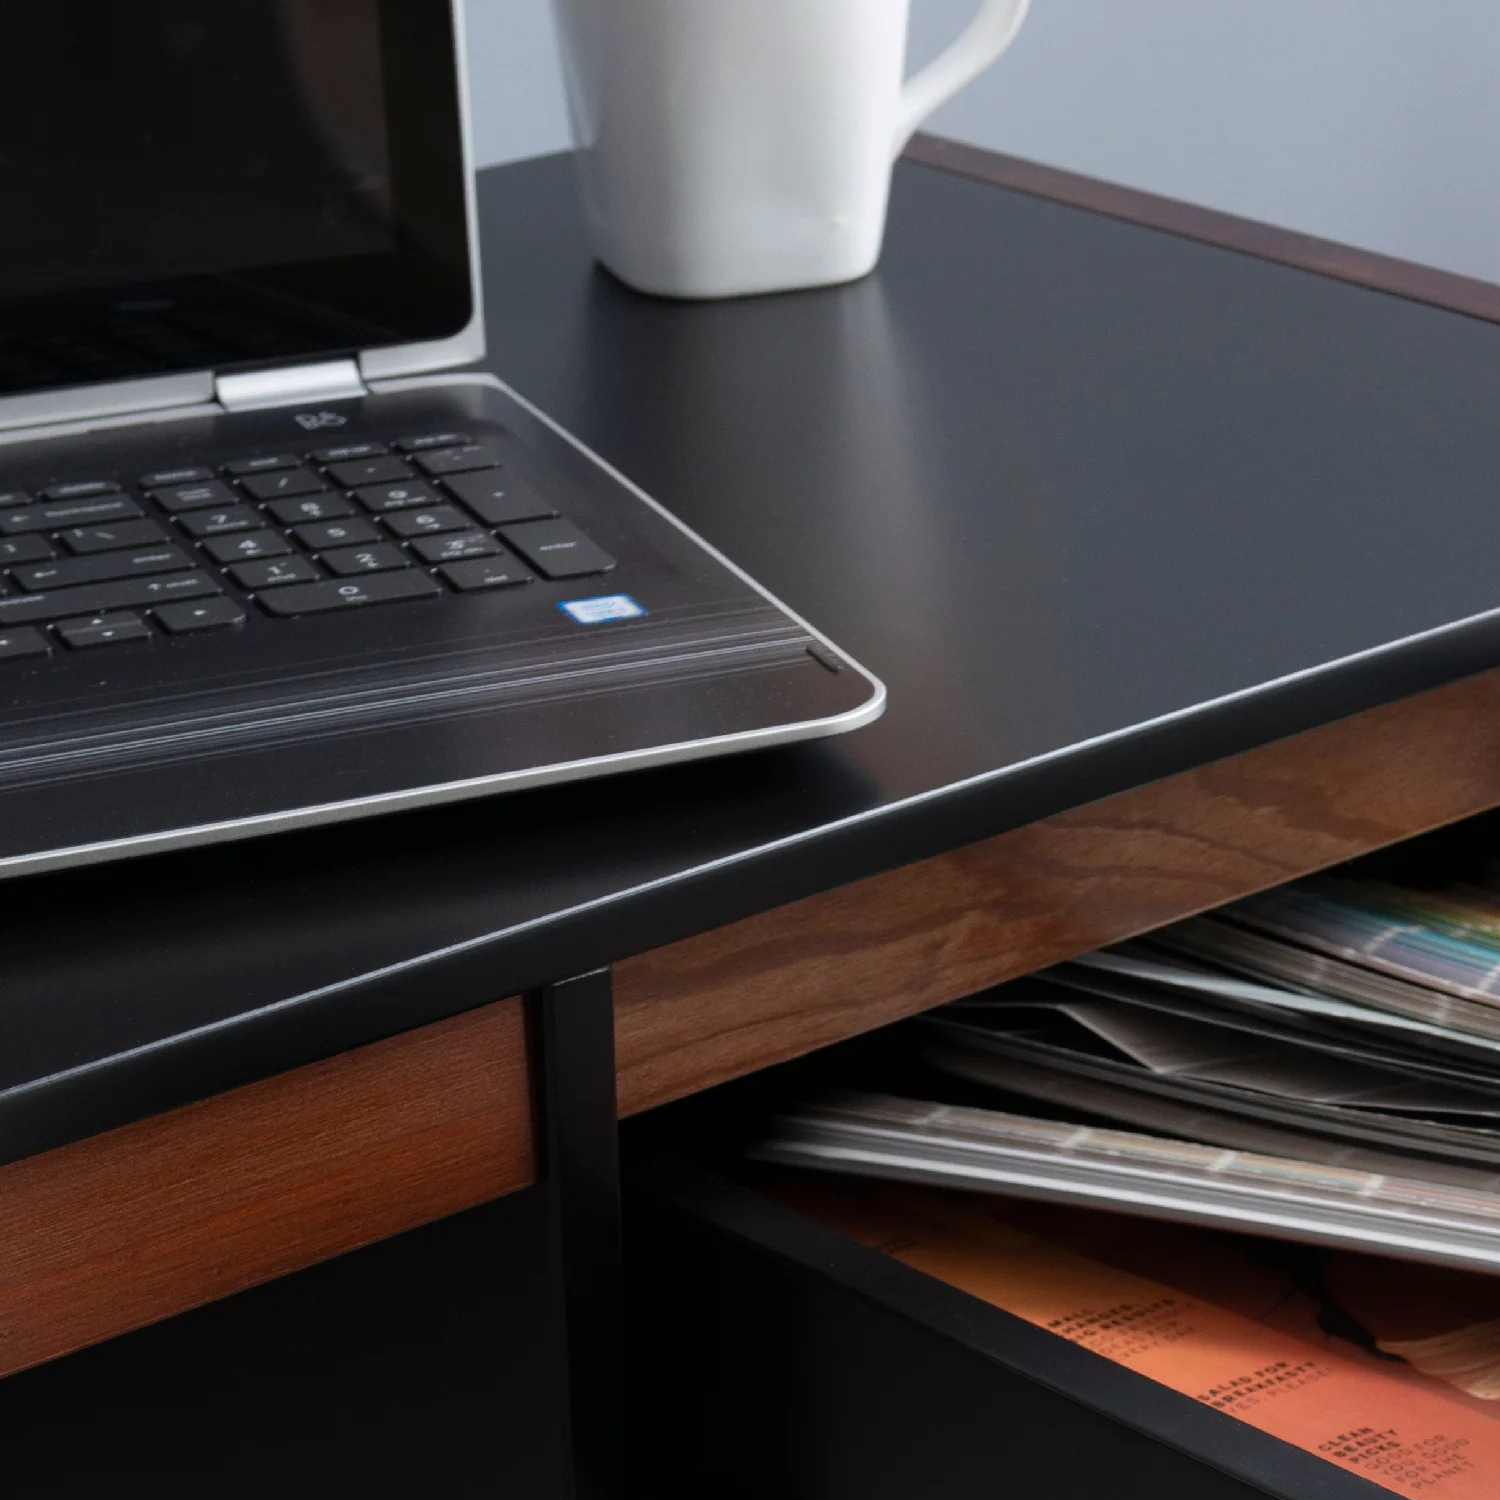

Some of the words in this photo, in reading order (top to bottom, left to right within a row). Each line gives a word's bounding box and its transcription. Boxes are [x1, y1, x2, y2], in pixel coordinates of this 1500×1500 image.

[1047, 1308, 1096, 1328] MALL
[1197, 1375, 1253, 1402] SALAD
[1253, 1361, 1288, 1378] FOR
[1317, 1426, 1374, 1452] CLEAN
[1332, 1428, 1398, 1458] BEAUTY
[1348, 1441, 1401, 1464] PICKS
[1364, 1448, 1413, 1471] GOOD
[1413, 1434, 1446, 1450] FOR
[1421, 1437, 1470, 1460] GOOD
[1395, 1465, 1428, 1484] FOR
[1430, 1452, 1467, 1468] THE
[1410, 1460, 1476, 1490] PLANET
